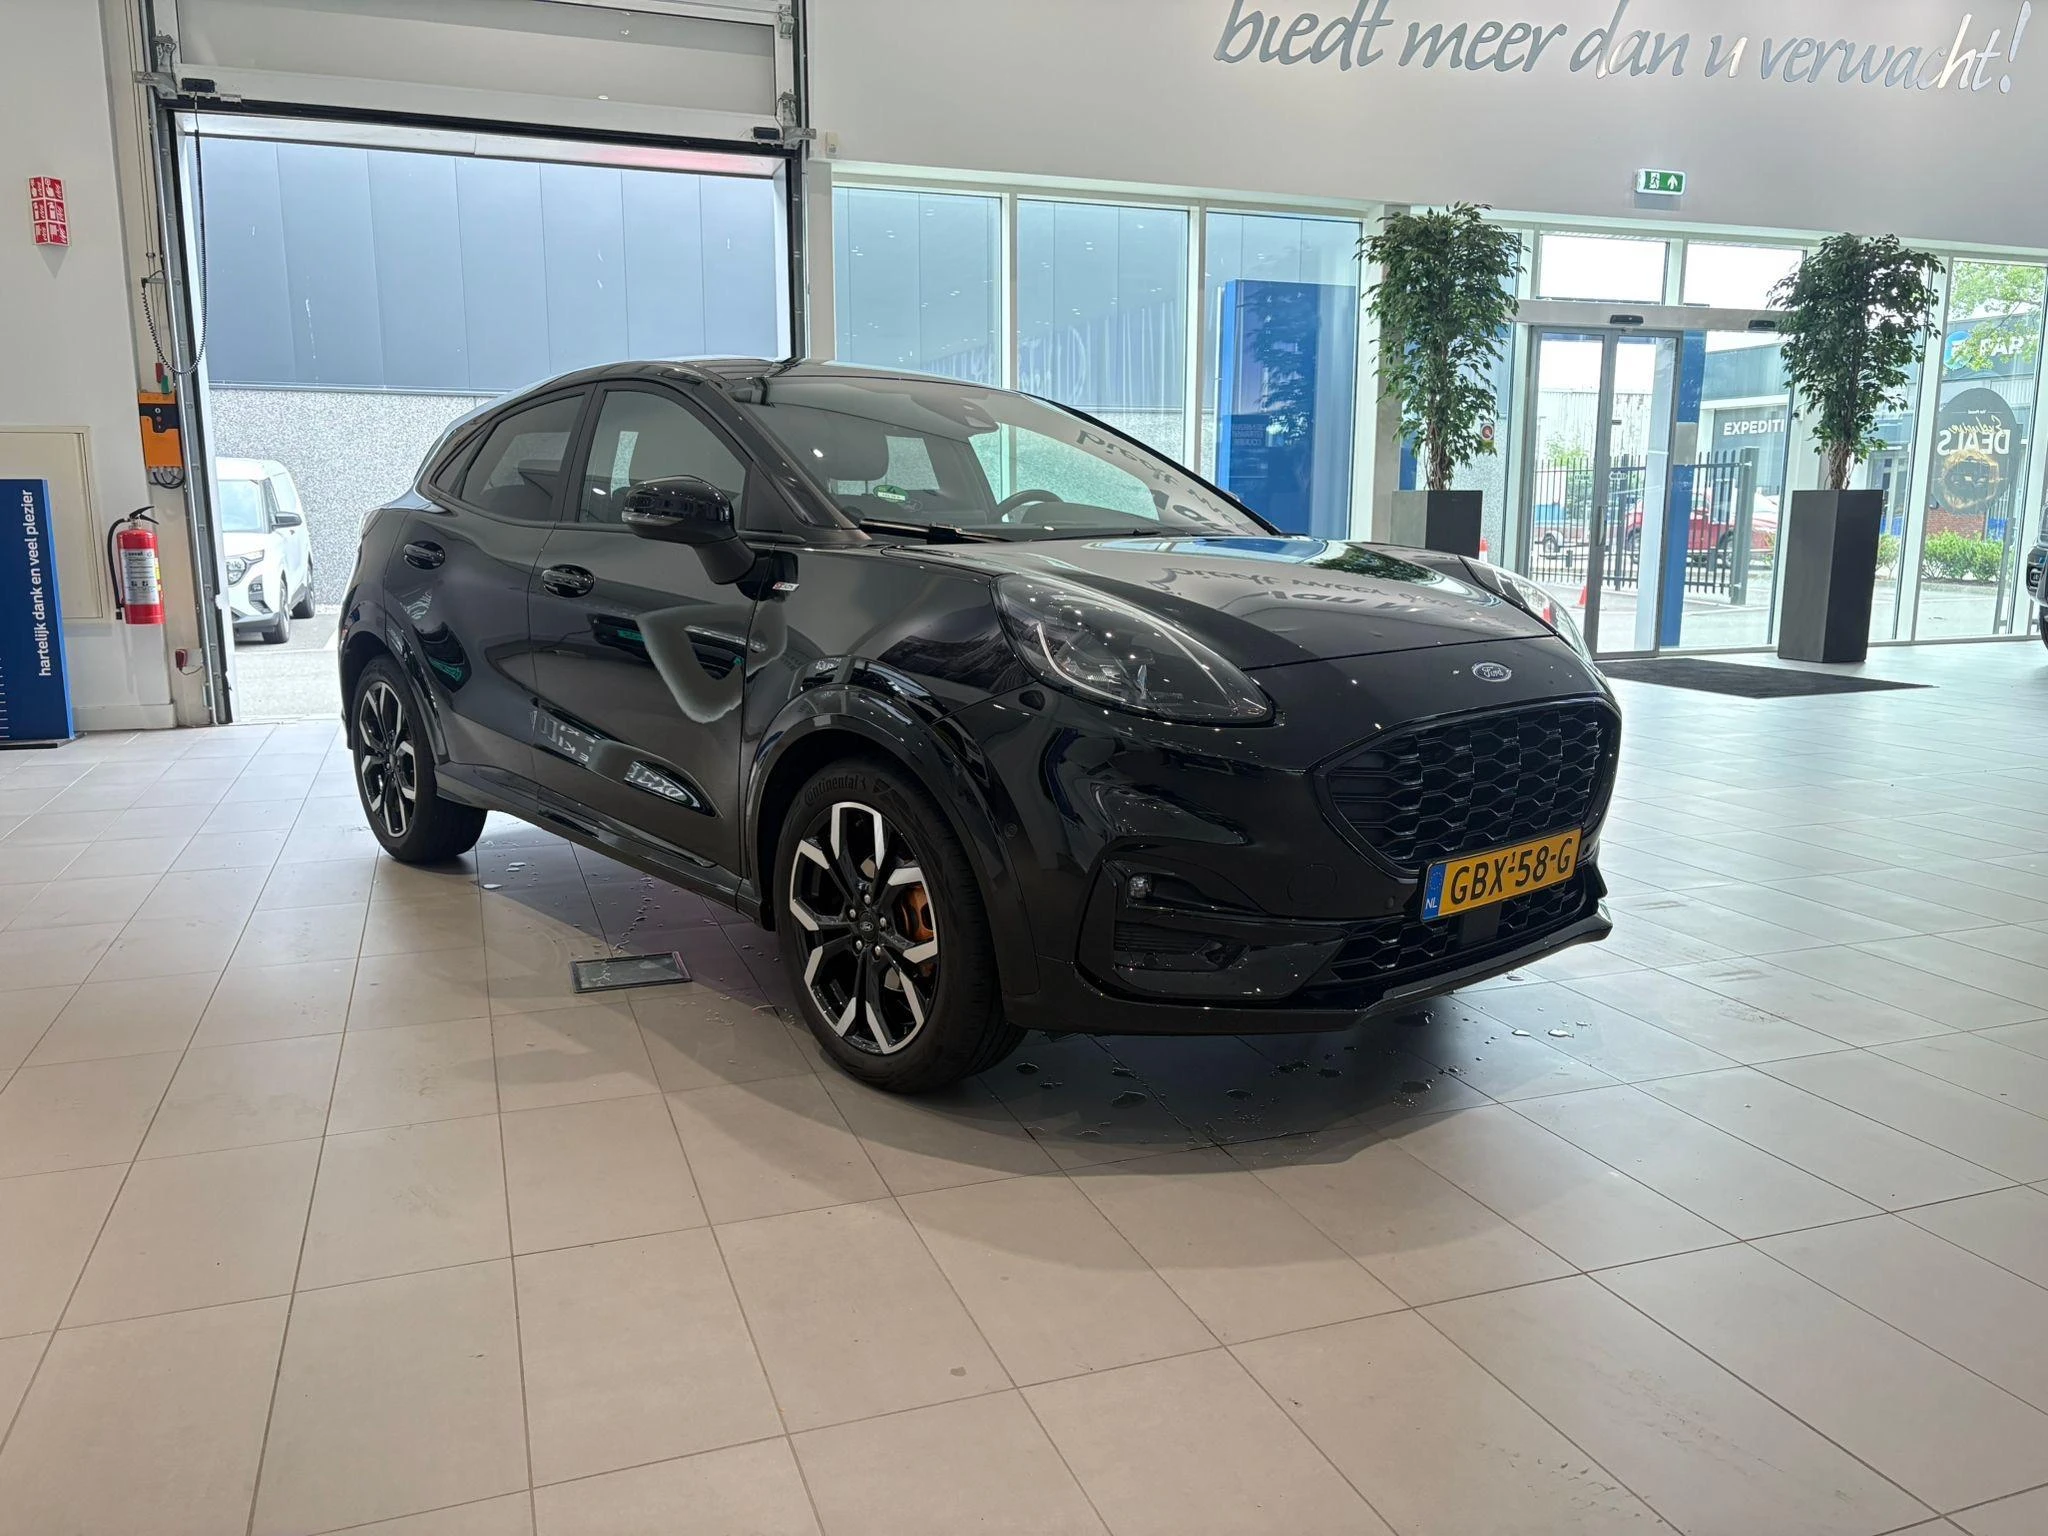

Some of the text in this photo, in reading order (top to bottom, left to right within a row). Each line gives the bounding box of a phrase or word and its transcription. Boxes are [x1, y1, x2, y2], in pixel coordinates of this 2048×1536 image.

[1398, 21, 1567, 72] meer
[1569, 0, 1690, 80] dan
[1705, 33, 1748, 78] u
[1760, 0, 2033, 93] verwacht!
[1723, 418, 1785, 436] EXPEDITI
[21, 489, 51, 677] hartelijk dank en veel plezier
[1425, 898, 1438, 910] NL
[1450, 837, 1573, 905] GBX-58-G
